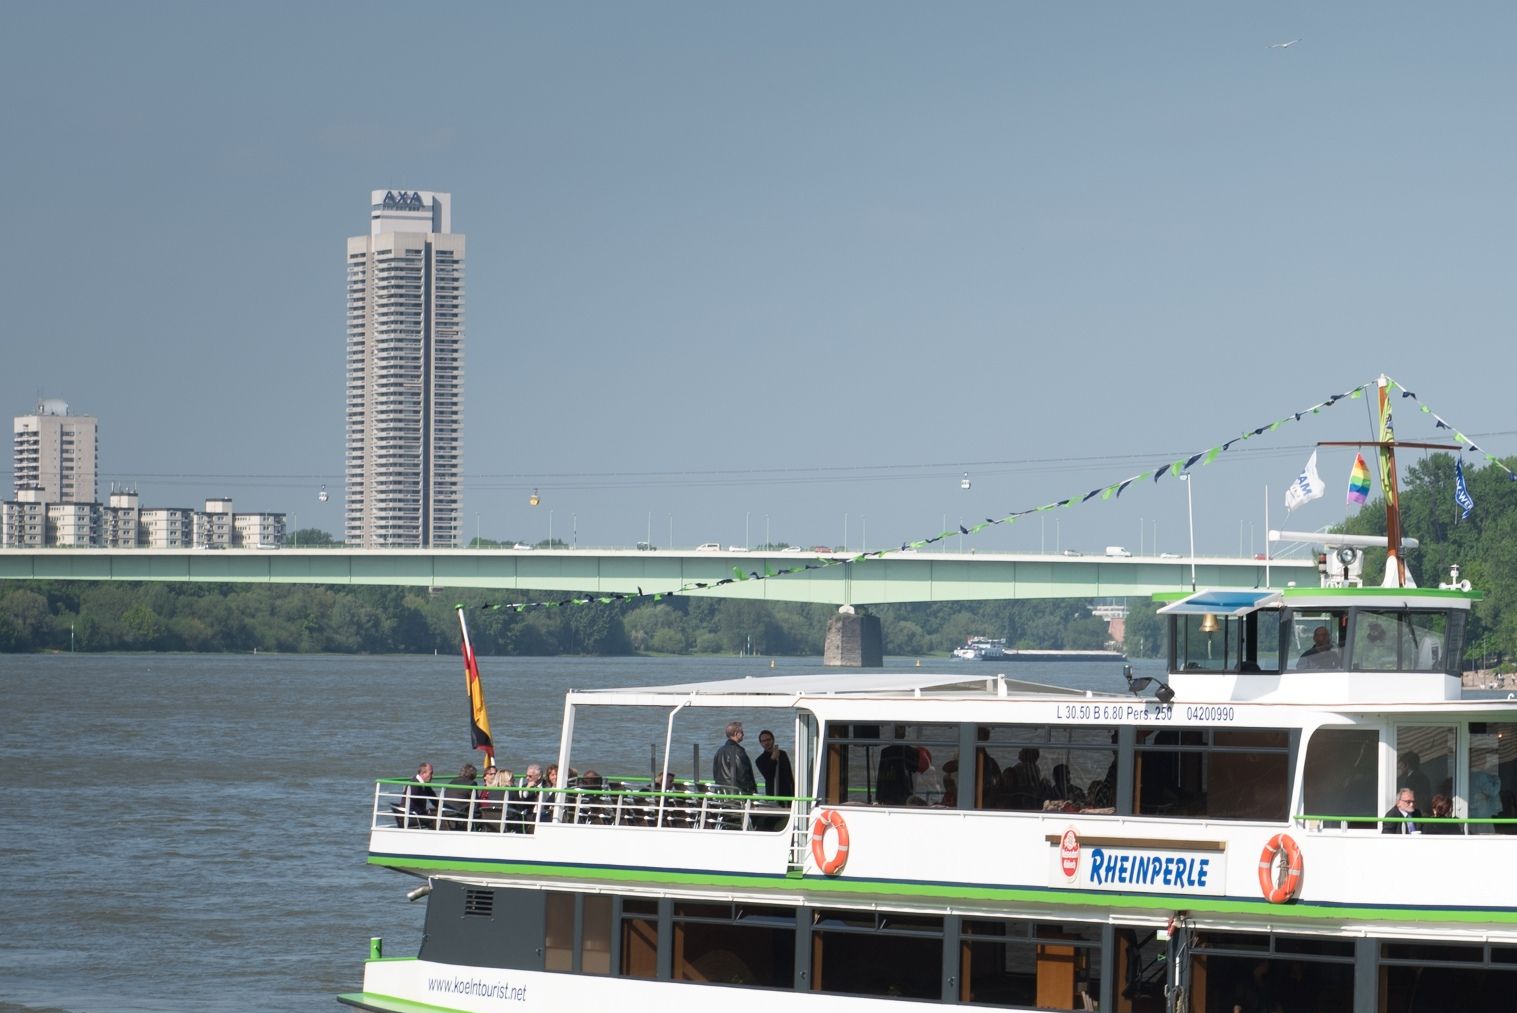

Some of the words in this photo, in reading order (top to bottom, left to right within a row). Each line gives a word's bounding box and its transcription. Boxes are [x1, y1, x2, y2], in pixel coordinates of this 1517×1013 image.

[383, 191, 422, 210] AXA
[1057, 705, 1063, 719] L
[1065, 705, 1090, 719] 30.50
[1093, 706, 1101, 719] B
[1103, 706, 1123, 720] 6.80
[1126, 706, 1152, 720] Pers.
[1154, 706, 1173, 721] 250
[1186, 707, 1235, 721] 04200990
[1090, 849, 1209, 888] RHEINPERLE
[428, 976, 527, 1002] www.koelntourist.net
